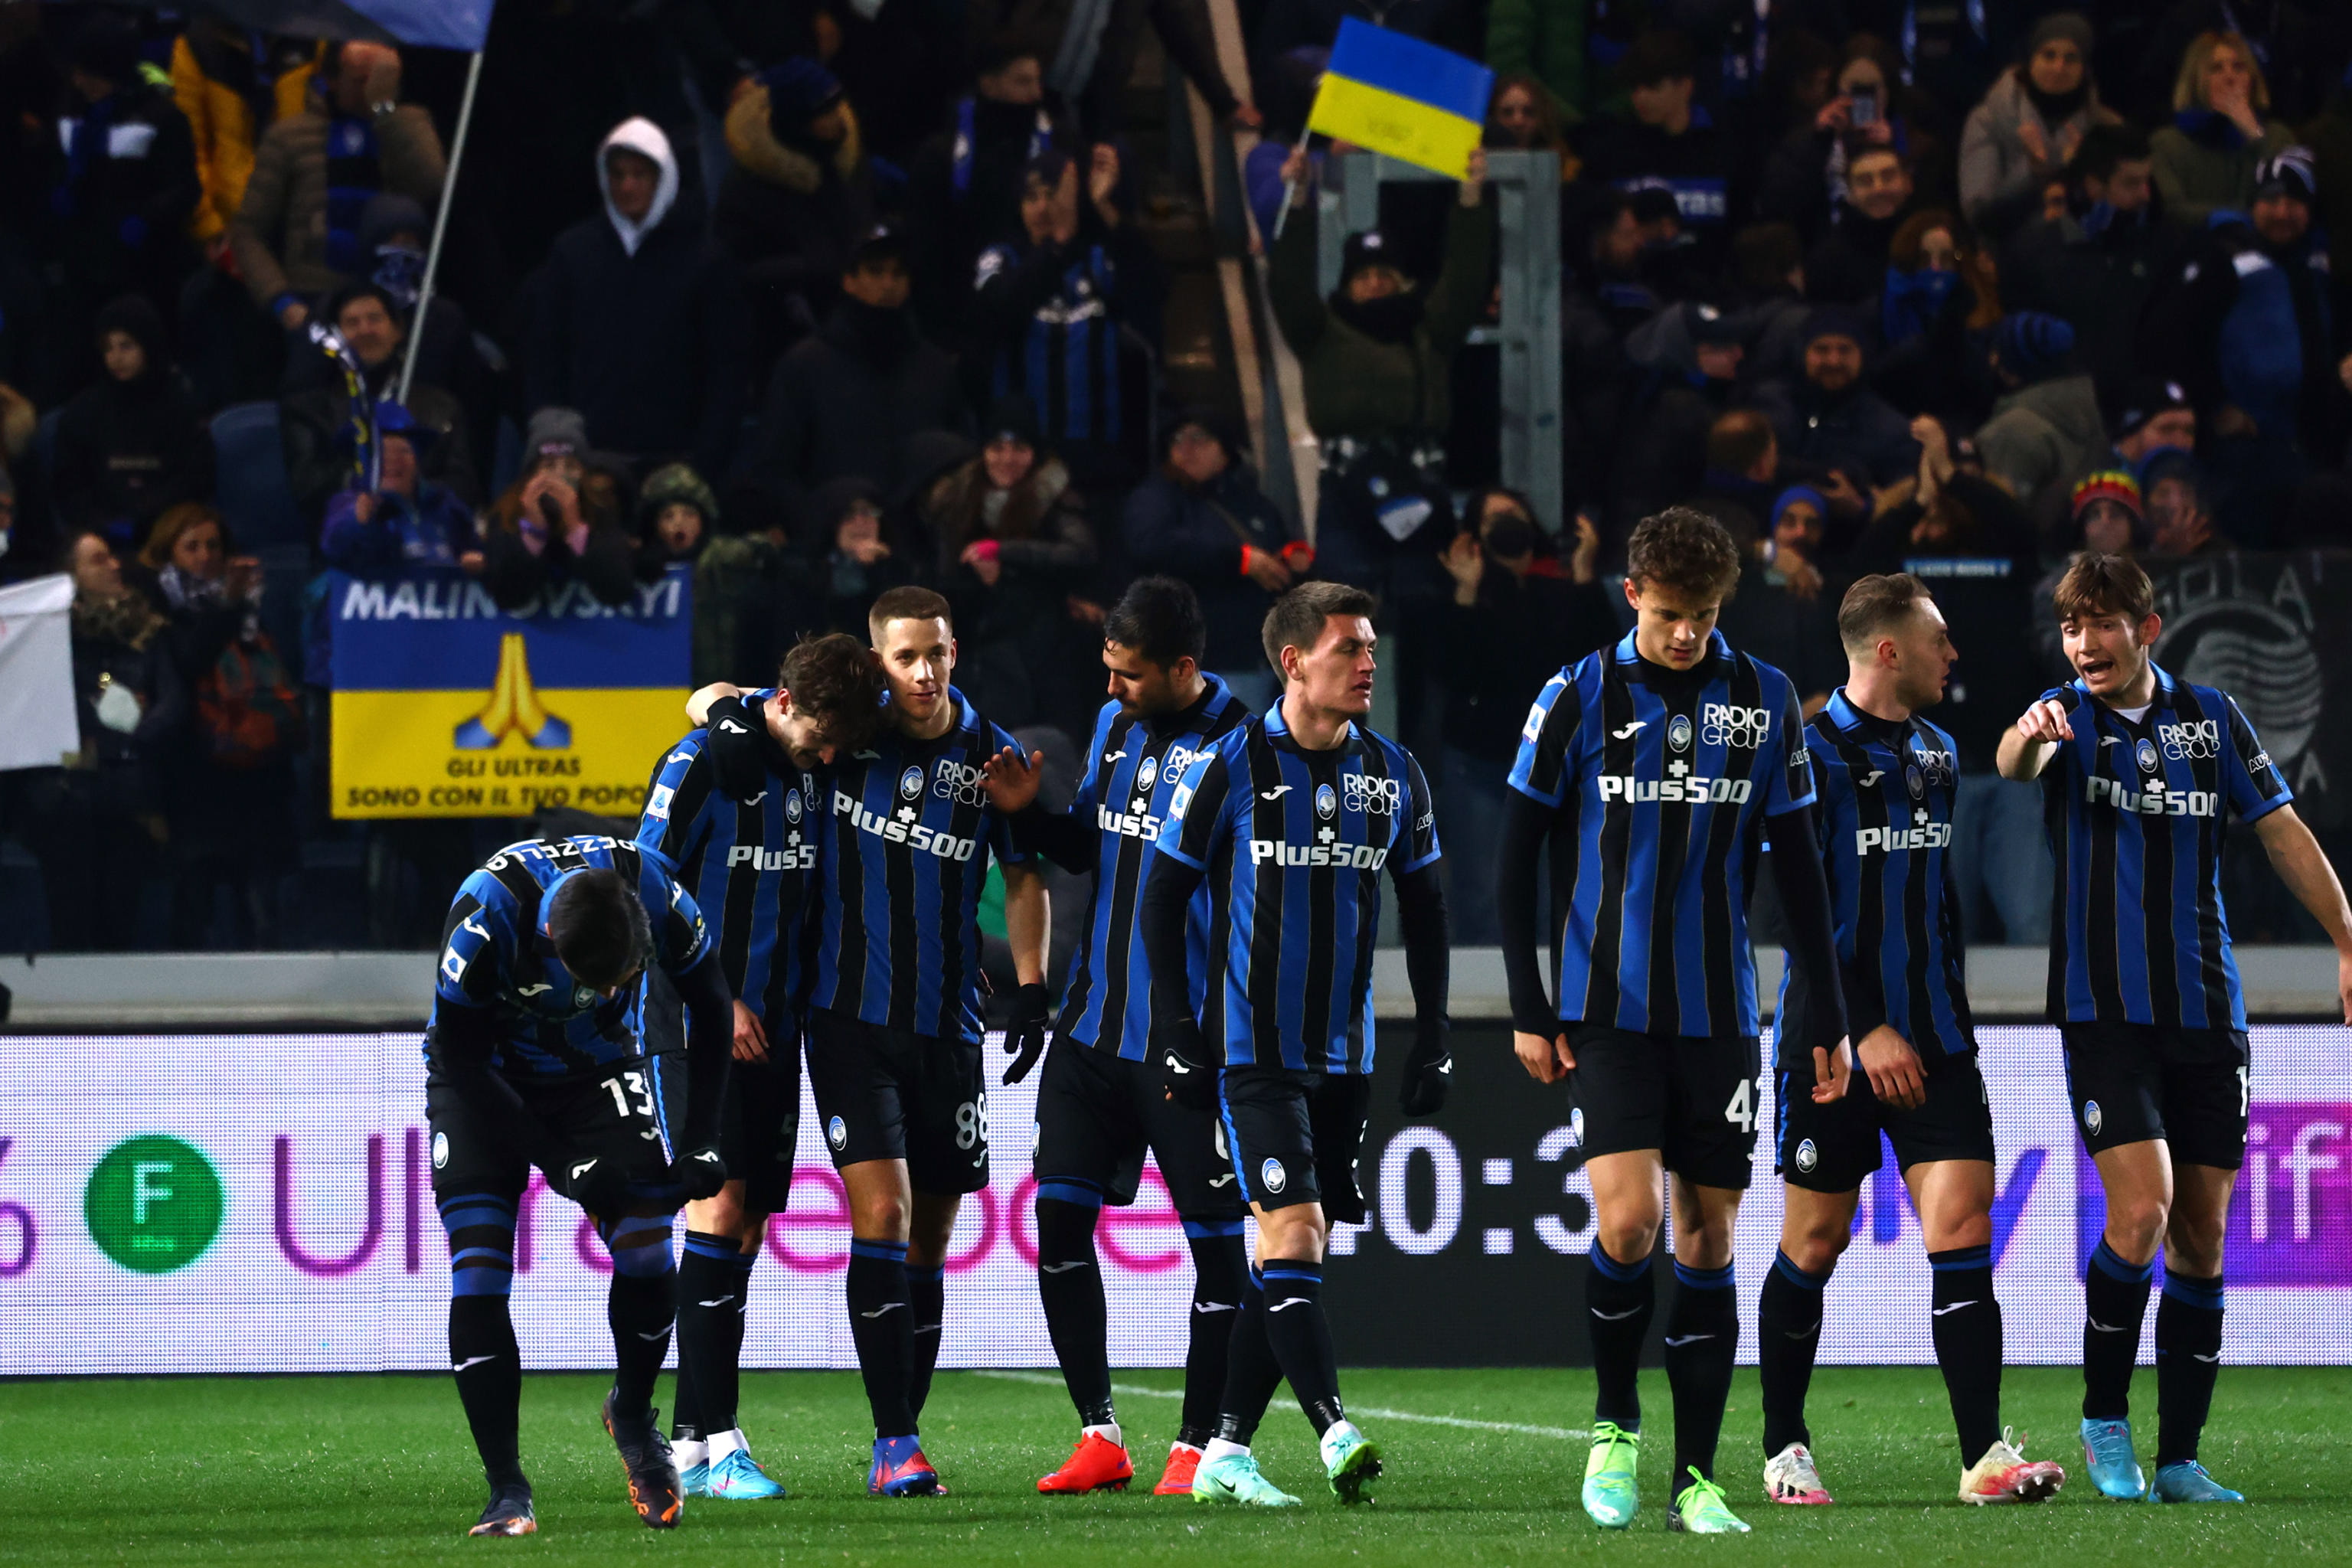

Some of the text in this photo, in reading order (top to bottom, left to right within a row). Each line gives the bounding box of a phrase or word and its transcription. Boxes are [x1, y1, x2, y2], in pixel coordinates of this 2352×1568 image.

[1704, 702, 1771, 732] RADICI
[1701, 724, 1769, 750] GROUP
[2158, 720, 2220, 744] RADICI
[2164, 740, 2221, 760] GROUP
[446, 757, 581, 778] GLI ULTRAS
[348, 786, 420, 808] SONO
[429, 786, 483, 807] CON
[490, 786, 511, 807] IL
[1343, 773, 1400, 799] RADICI
[1597, 775, 1753, 805] Plus500
[2086, 776, 2219, 818] Plus500
[1344, 792, 1401, 816] GROUP
[831, 790, 976, 862] Plus500
[1250, 839, 1388, 871] Plus500
[600, 1072, 652, 1117] 13
[956, 1092, 988, 1151] 88
